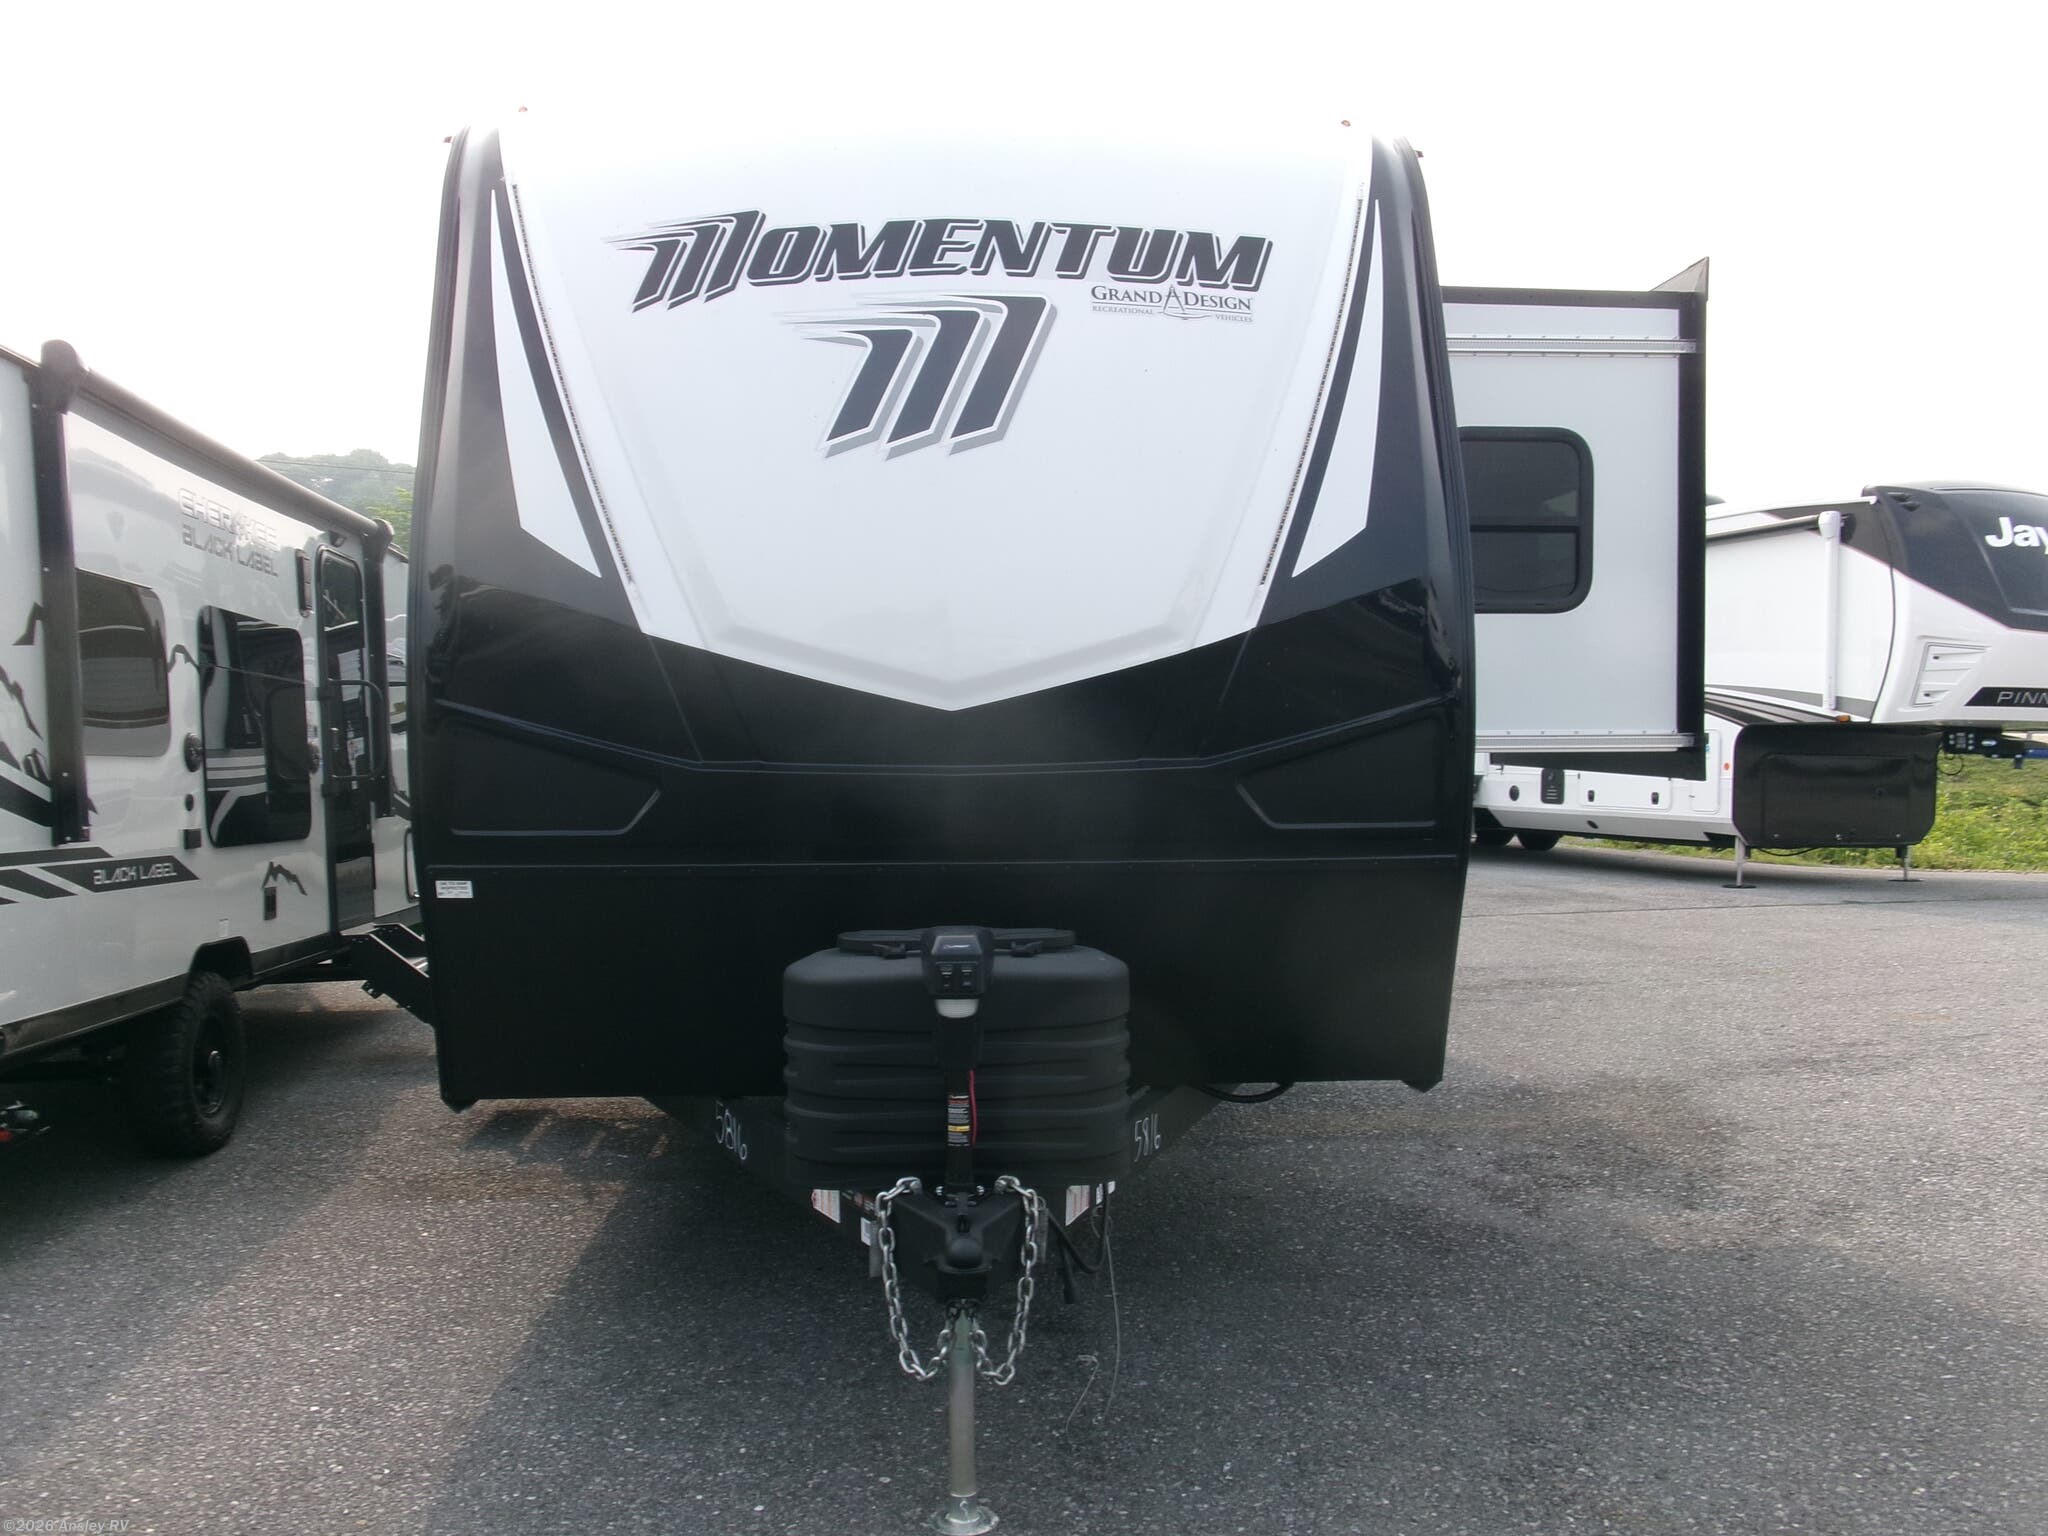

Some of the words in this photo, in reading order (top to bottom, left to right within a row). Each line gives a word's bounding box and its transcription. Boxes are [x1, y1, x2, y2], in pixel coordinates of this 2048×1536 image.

[603, 208, 1274, 314] MOMENTUM
[1090, 284, 1163, 304] GRAND
[1183, 290, 1252, 311] DESIGN
[1091, 305, 1154, 316] RECREATIONAL
[1214, 313, 1254, 324] VEHICLES
[182, 523, 234, 563] BLACK
[236, 544, 280, 578] LABEL
[92, 865, 137, 886] BLACK
[139, 861, 179, 881] LABEL
[714, 1099, 748, 1161] 5816
[1133, 1112, 1162, 1163] 5816
